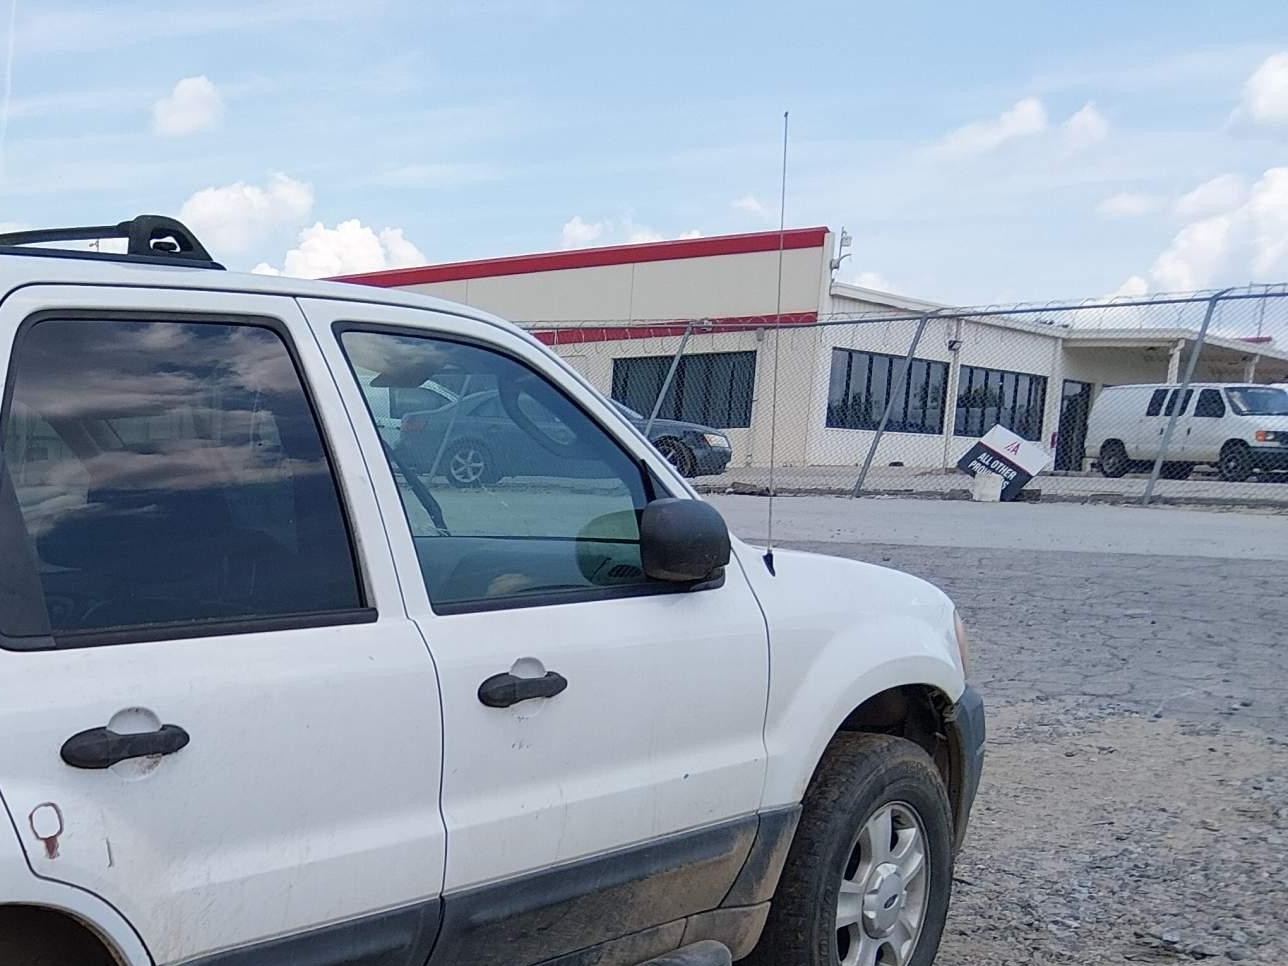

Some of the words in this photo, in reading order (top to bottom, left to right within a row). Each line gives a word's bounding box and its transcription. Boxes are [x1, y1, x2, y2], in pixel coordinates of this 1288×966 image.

[968, 460, 1009, 489] PROVIS
[978, 453, 991, 466] ALL
[991, 460, 1017, 480] OTHER
